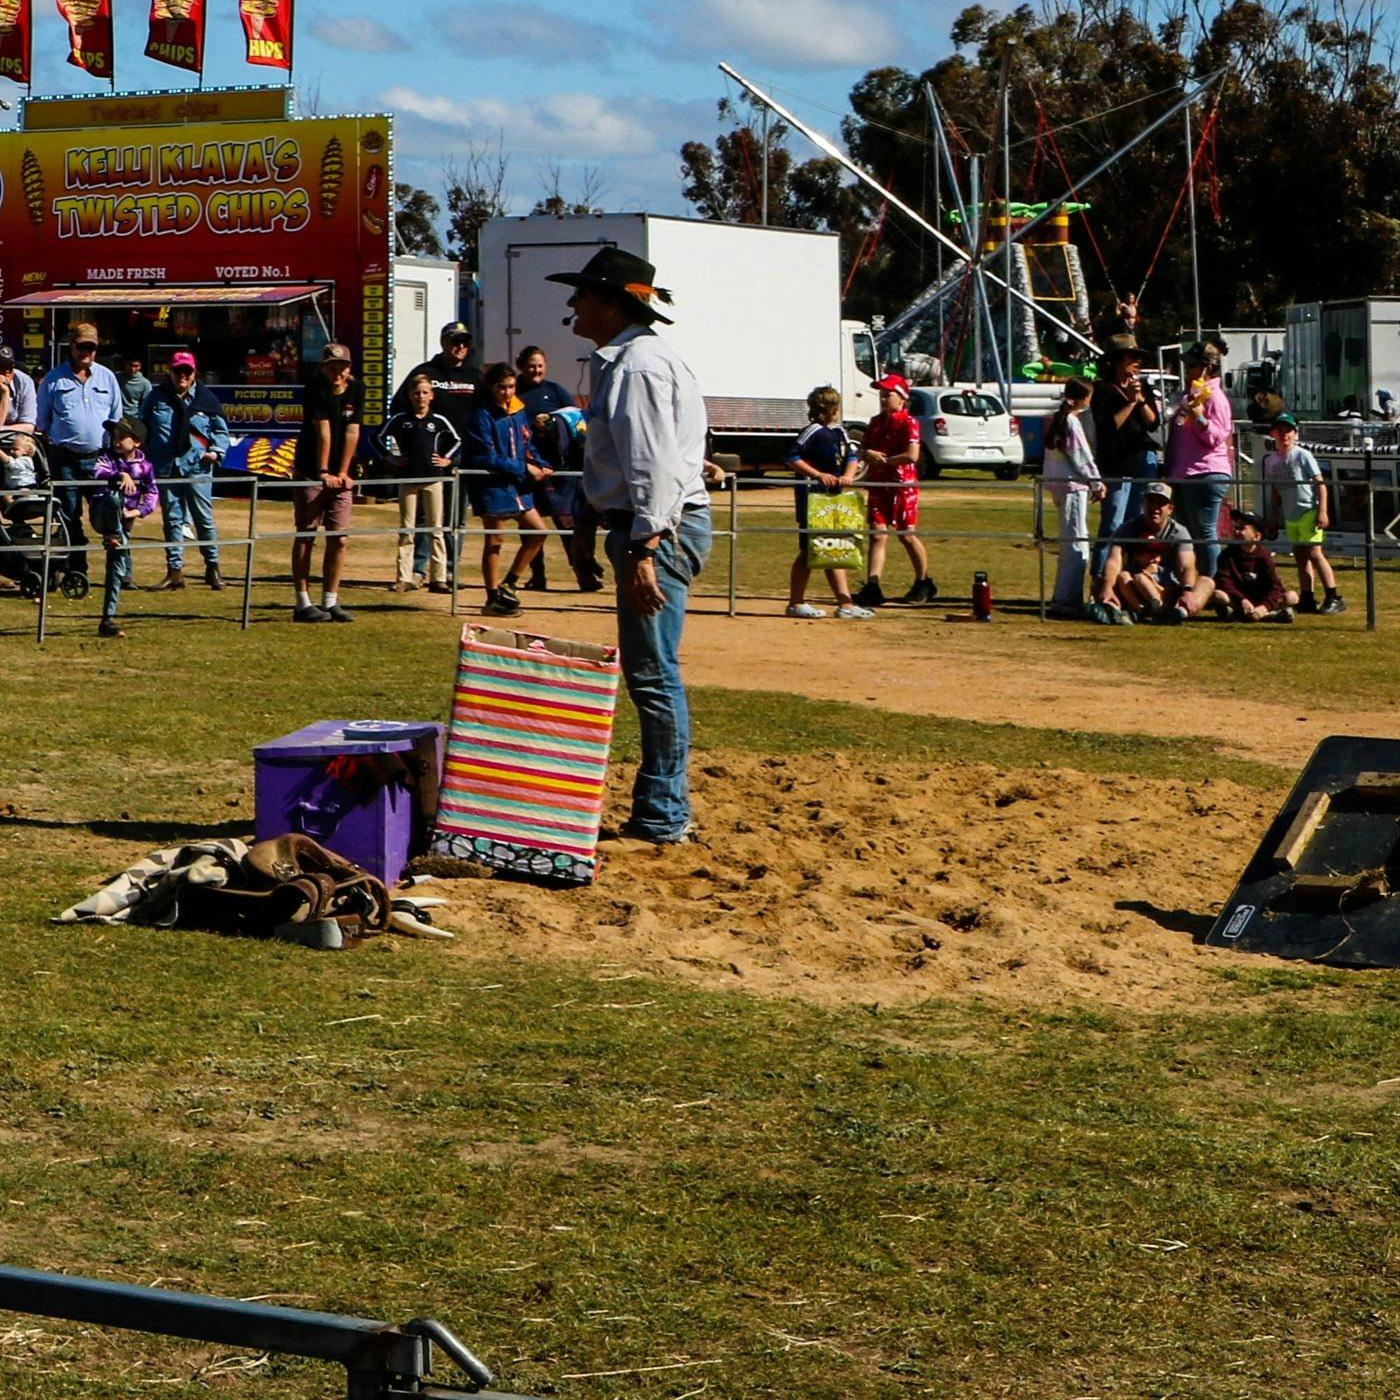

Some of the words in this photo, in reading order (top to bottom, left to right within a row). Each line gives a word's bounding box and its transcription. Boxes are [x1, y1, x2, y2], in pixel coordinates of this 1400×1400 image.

[249, 39, 285, 60] HIPS
[65, 145, 153, 189] KELLI
[157, 135, 302, 185] KLAVA'S
[52, 192, 202, 238] TWISTED
[205, 187, 311, 233] CHIPS
[21, 271, 47, 282] MENU
[86, 269, 125, 280] MADE
[126, 268, 167, 280] FRESH
[215, 266, 259, 278] VOTED
[262, 265, 291, 278] No.1
[234, 390, 268, 399] PICKUP
[270, 390, 294, 399] HERE
[221, 403, 273, 424] WISTED
[274, 403, 305, 424] CHI
